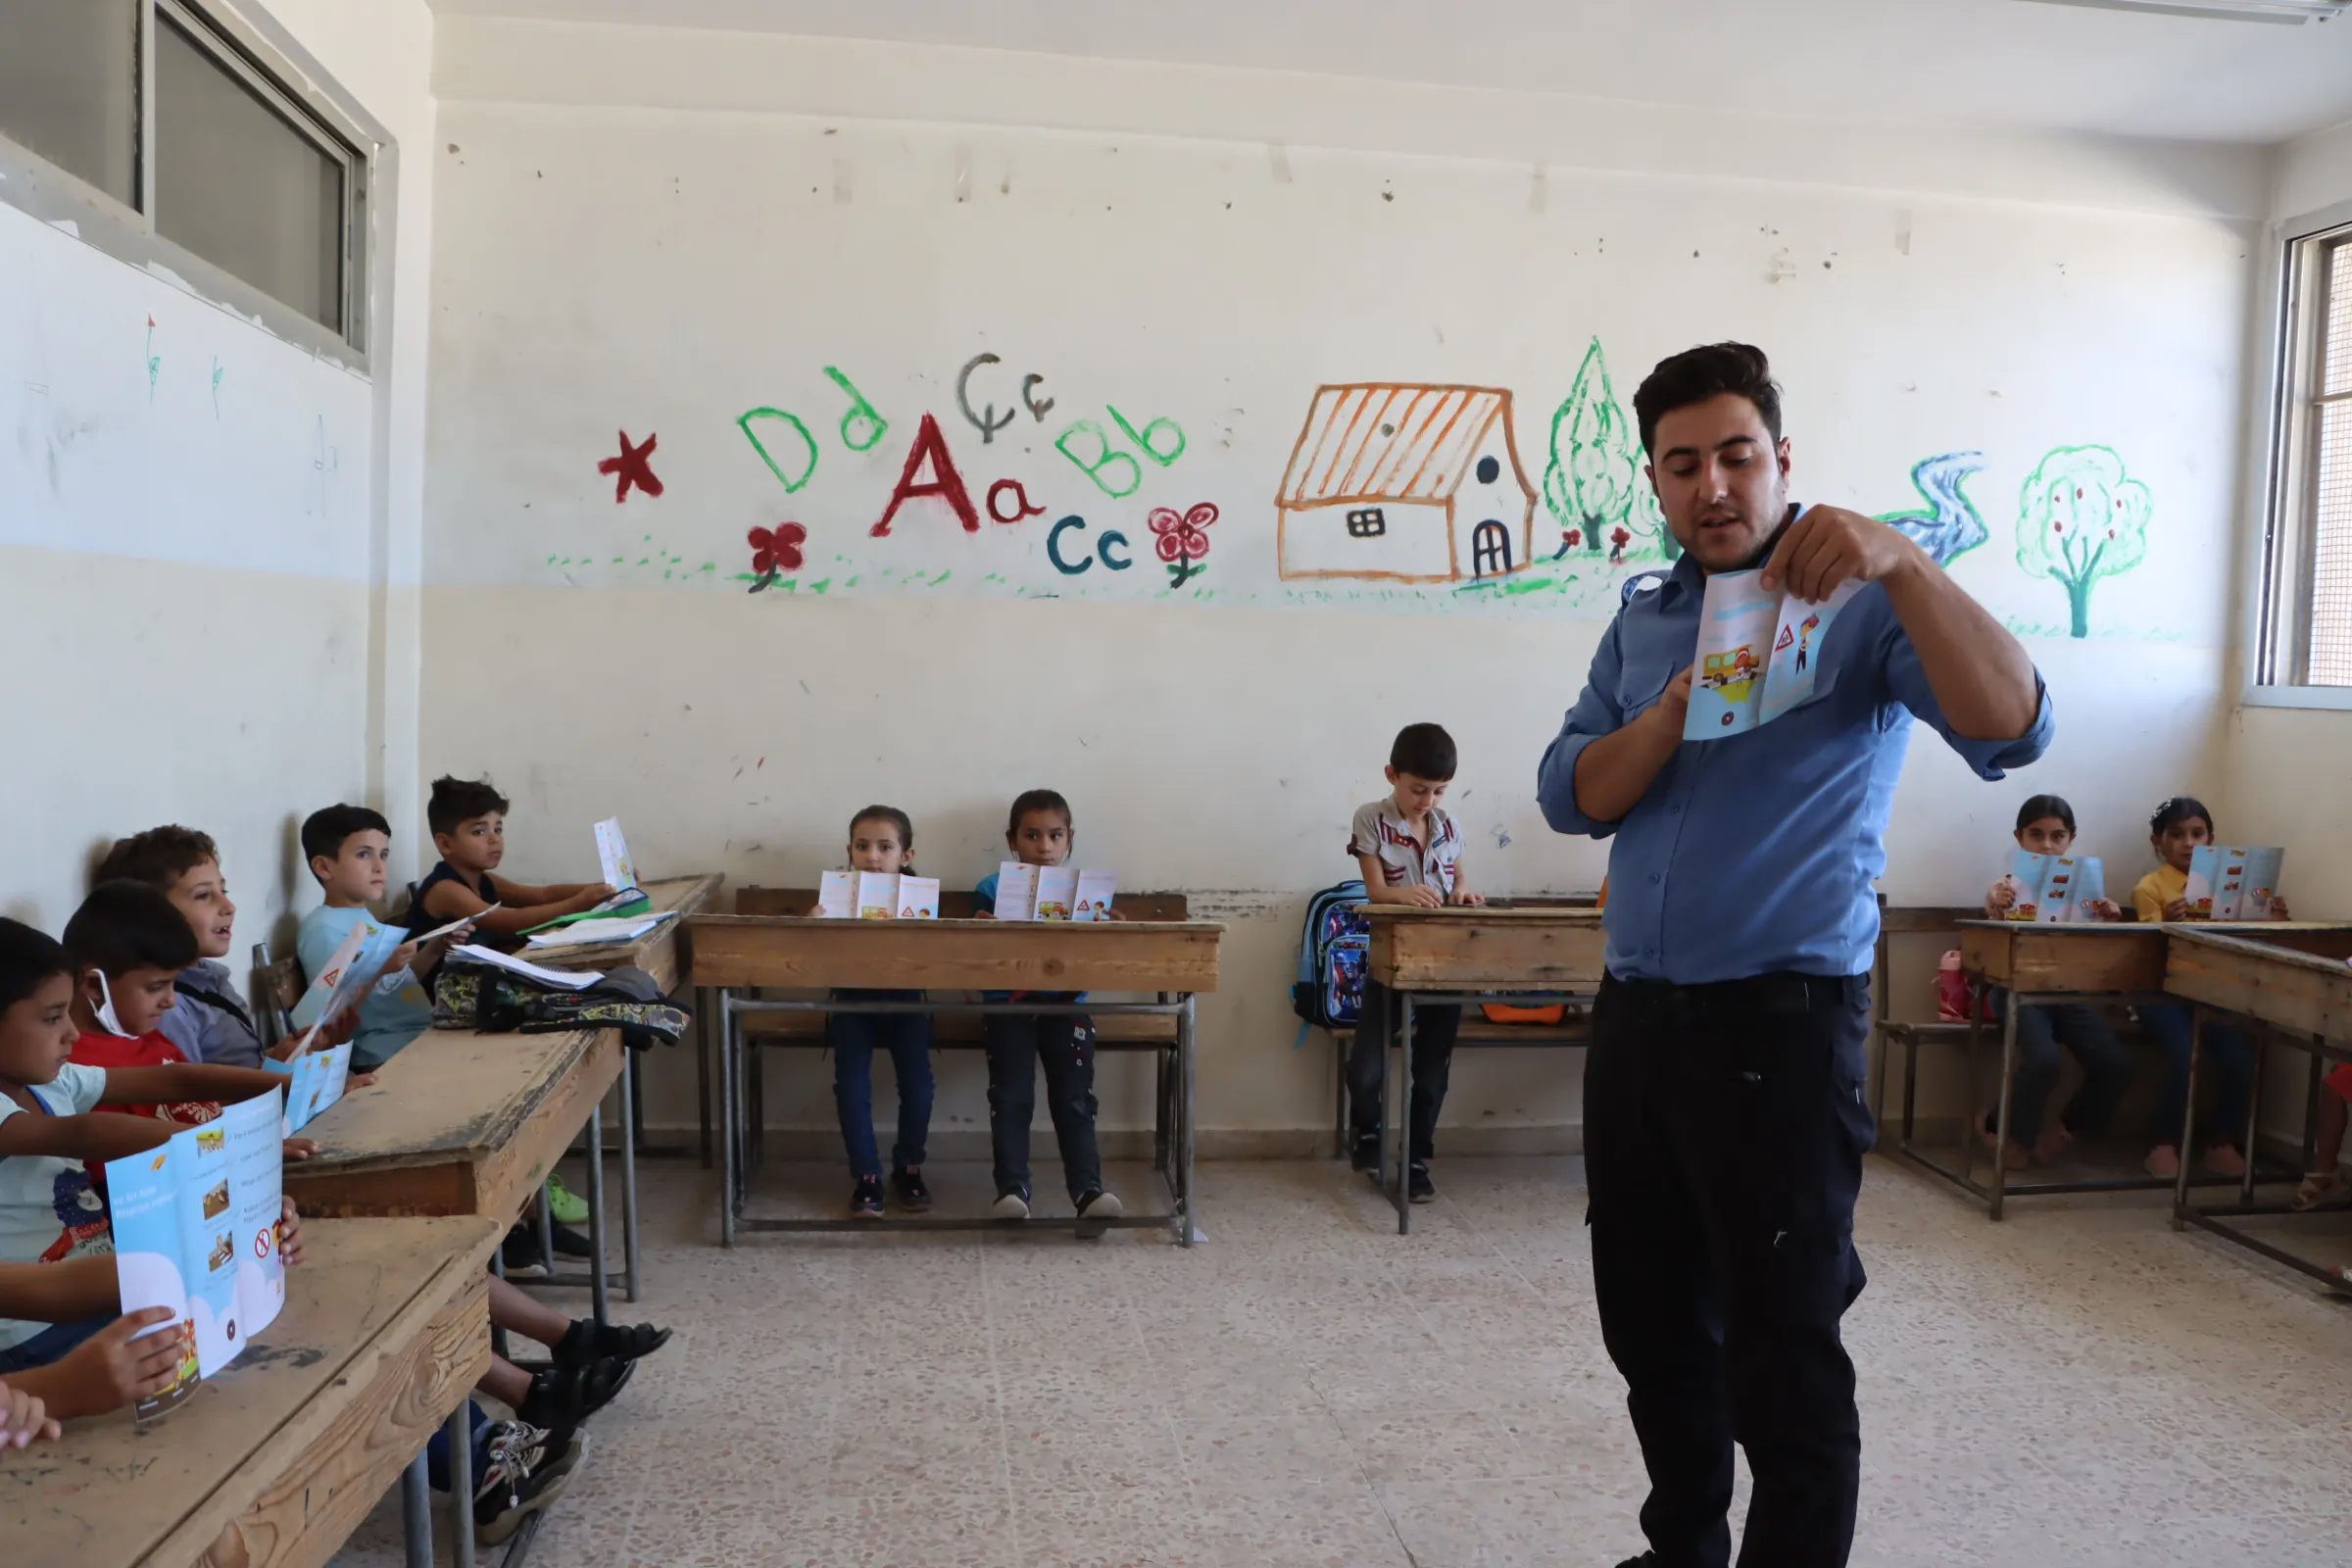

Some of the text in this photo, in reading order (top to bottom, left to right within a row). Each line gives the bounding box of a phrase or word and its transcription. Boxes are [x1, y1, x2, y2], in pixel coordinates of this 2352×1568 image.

[869, 410, 1048, 538] Aa
[1054, 404, 1187, 500] Bb
[1046, 514, 1134, 576] Cc
